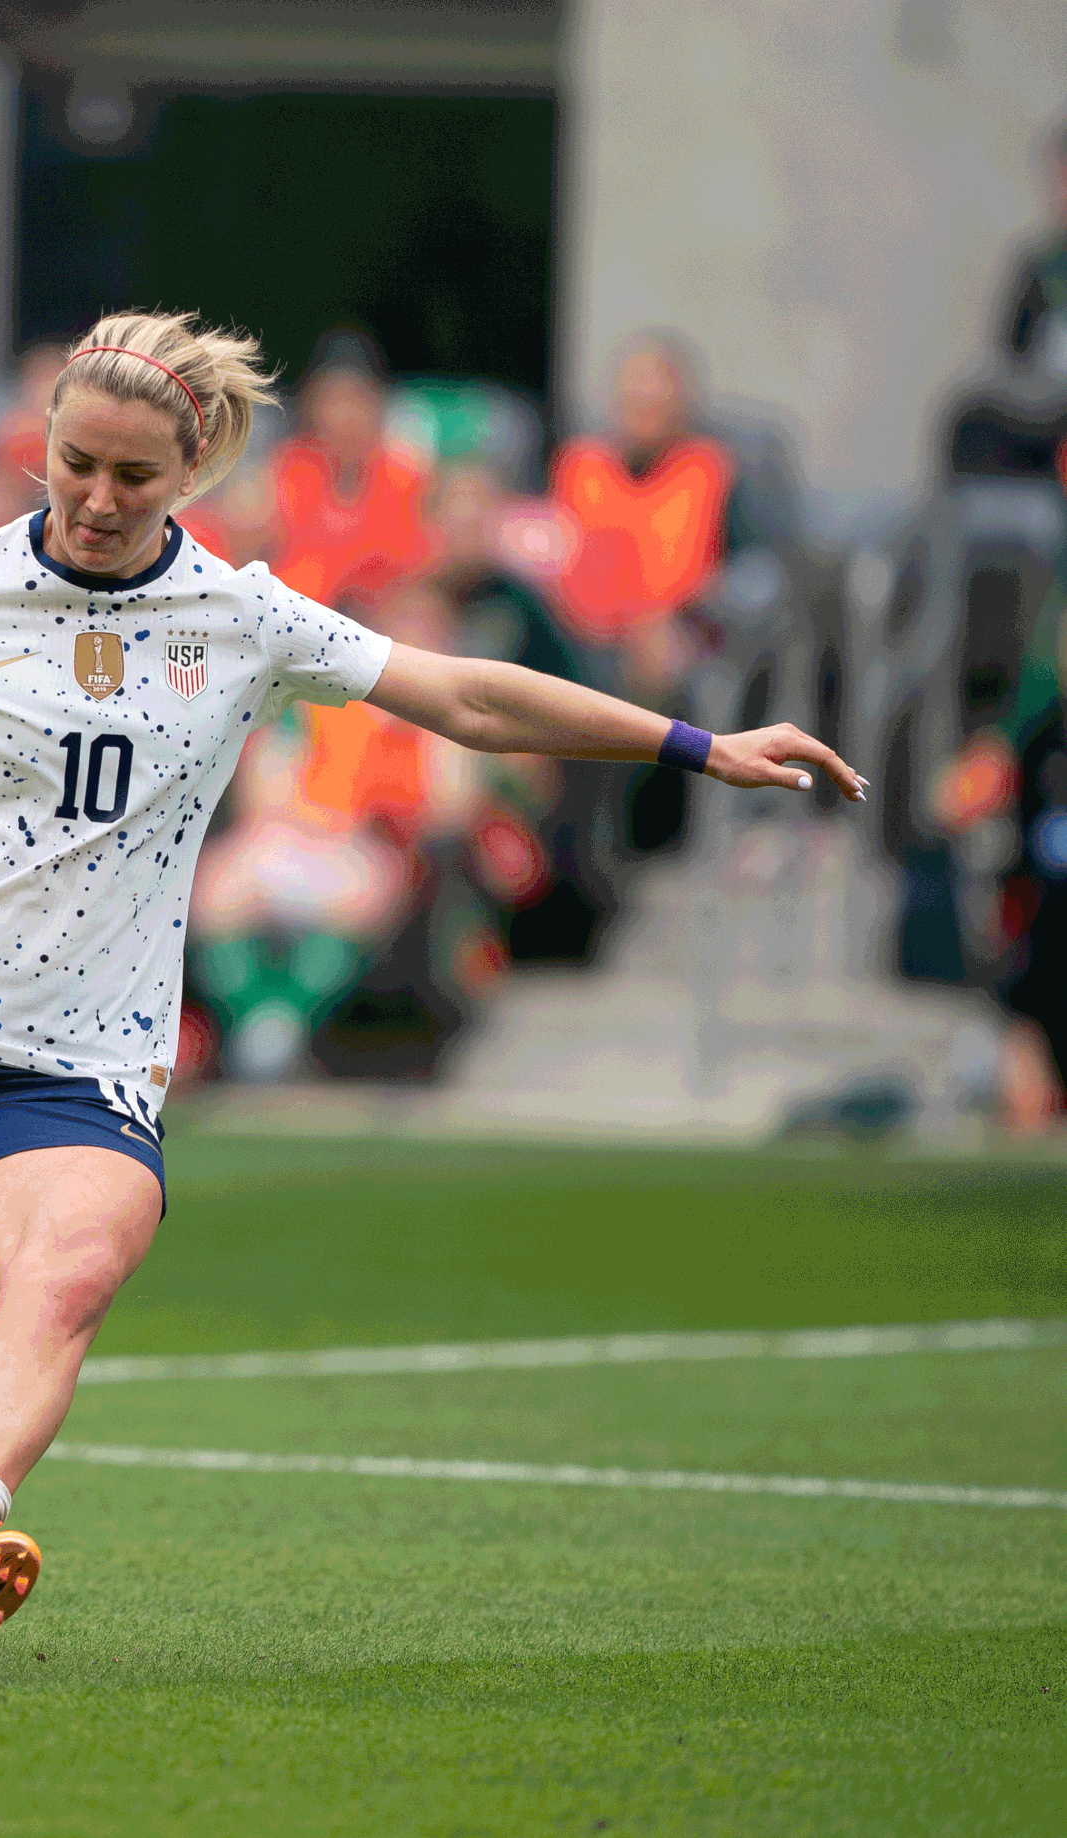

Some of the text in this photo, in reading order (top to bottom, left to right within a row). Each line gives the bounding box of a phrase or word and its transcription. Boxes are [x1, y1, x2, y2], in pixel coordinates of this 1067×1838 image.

[169, 645, 204, 667] USA
[88, 675, 111, 683] FIFA
[54, 732, 134, 823] 10
